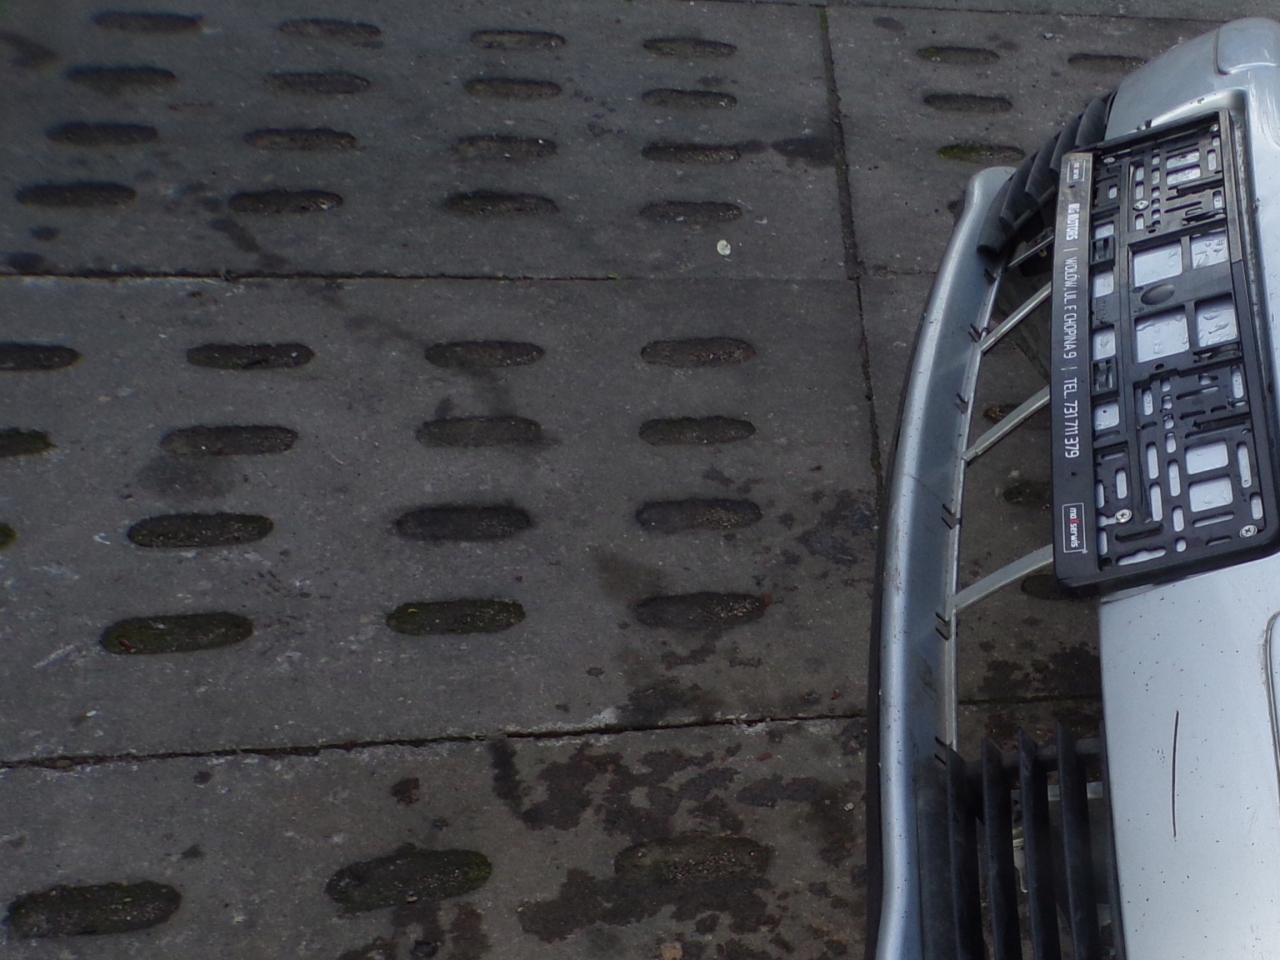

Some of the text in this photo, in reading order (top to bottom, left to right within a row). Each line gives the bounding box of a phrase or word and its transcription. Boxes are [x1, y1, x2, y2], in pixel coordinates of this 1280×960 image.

[1066, 213, 1080, 241] MOTORS
[1063, 313, 1077, 351] CHOPINA
[1063, 351, 1077, 359] 9
[1064, 377, 1077, 399] TEL.
[1064, 400, 1078, 418] 731
[1064, 419, 1078, 436] 711
[1064, 436, 1080, 458] 379
